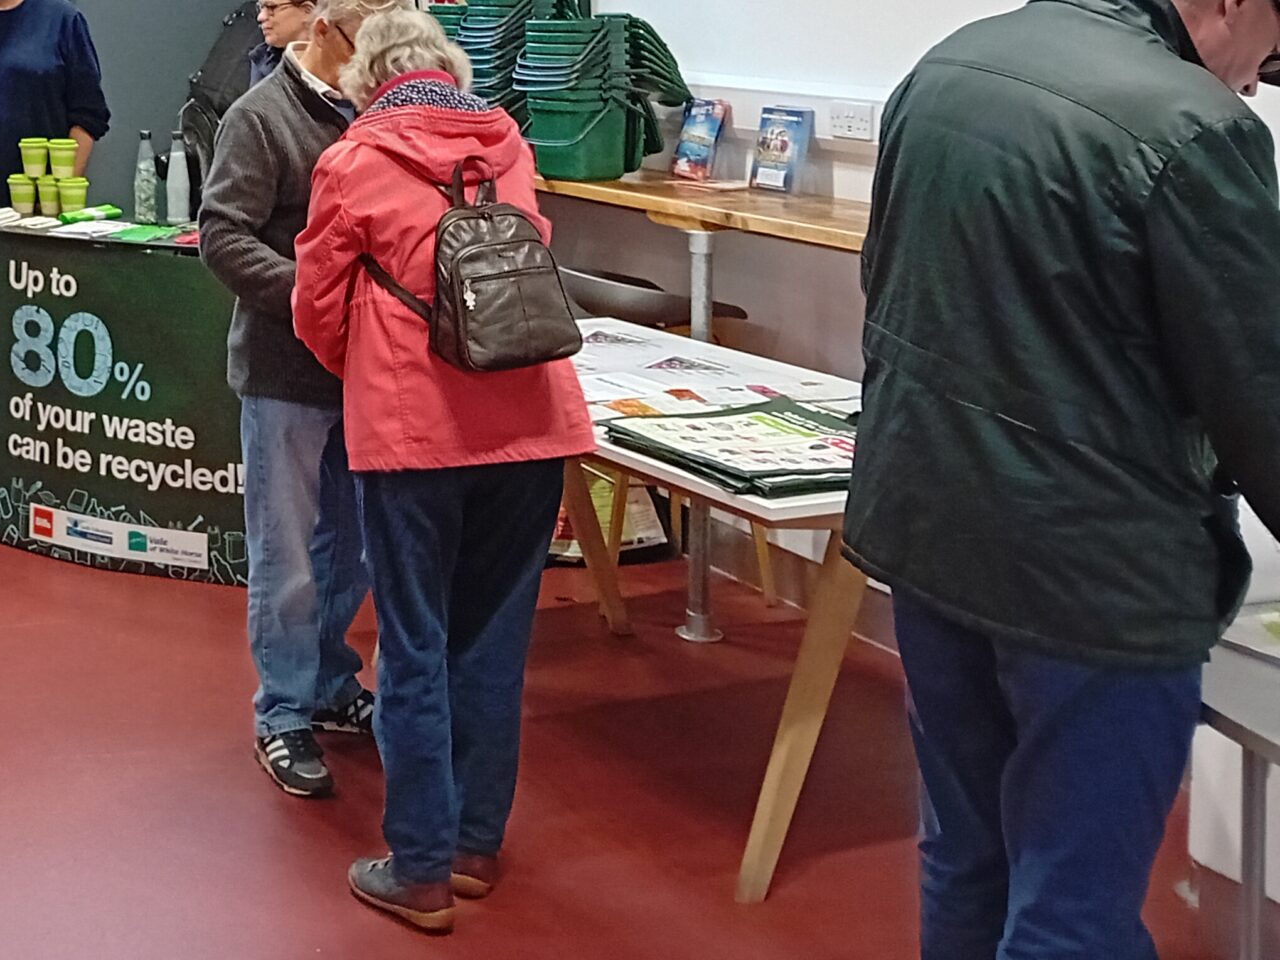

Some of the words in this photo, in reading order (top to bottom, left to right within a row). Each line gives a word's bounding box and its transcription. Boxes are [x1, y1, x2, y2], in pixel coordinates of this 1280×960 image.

[10, 259, 44, 298] Up
[49, 266, 78, 297] to
[10, 392, 33, 421] of
[37, 401, 96, 434] your
[102, 414, 195, 450] waste
[8, 433, 50, 464] can
[56, 437, 92, 473] be
[99, 452, 247, 494] recycled!
